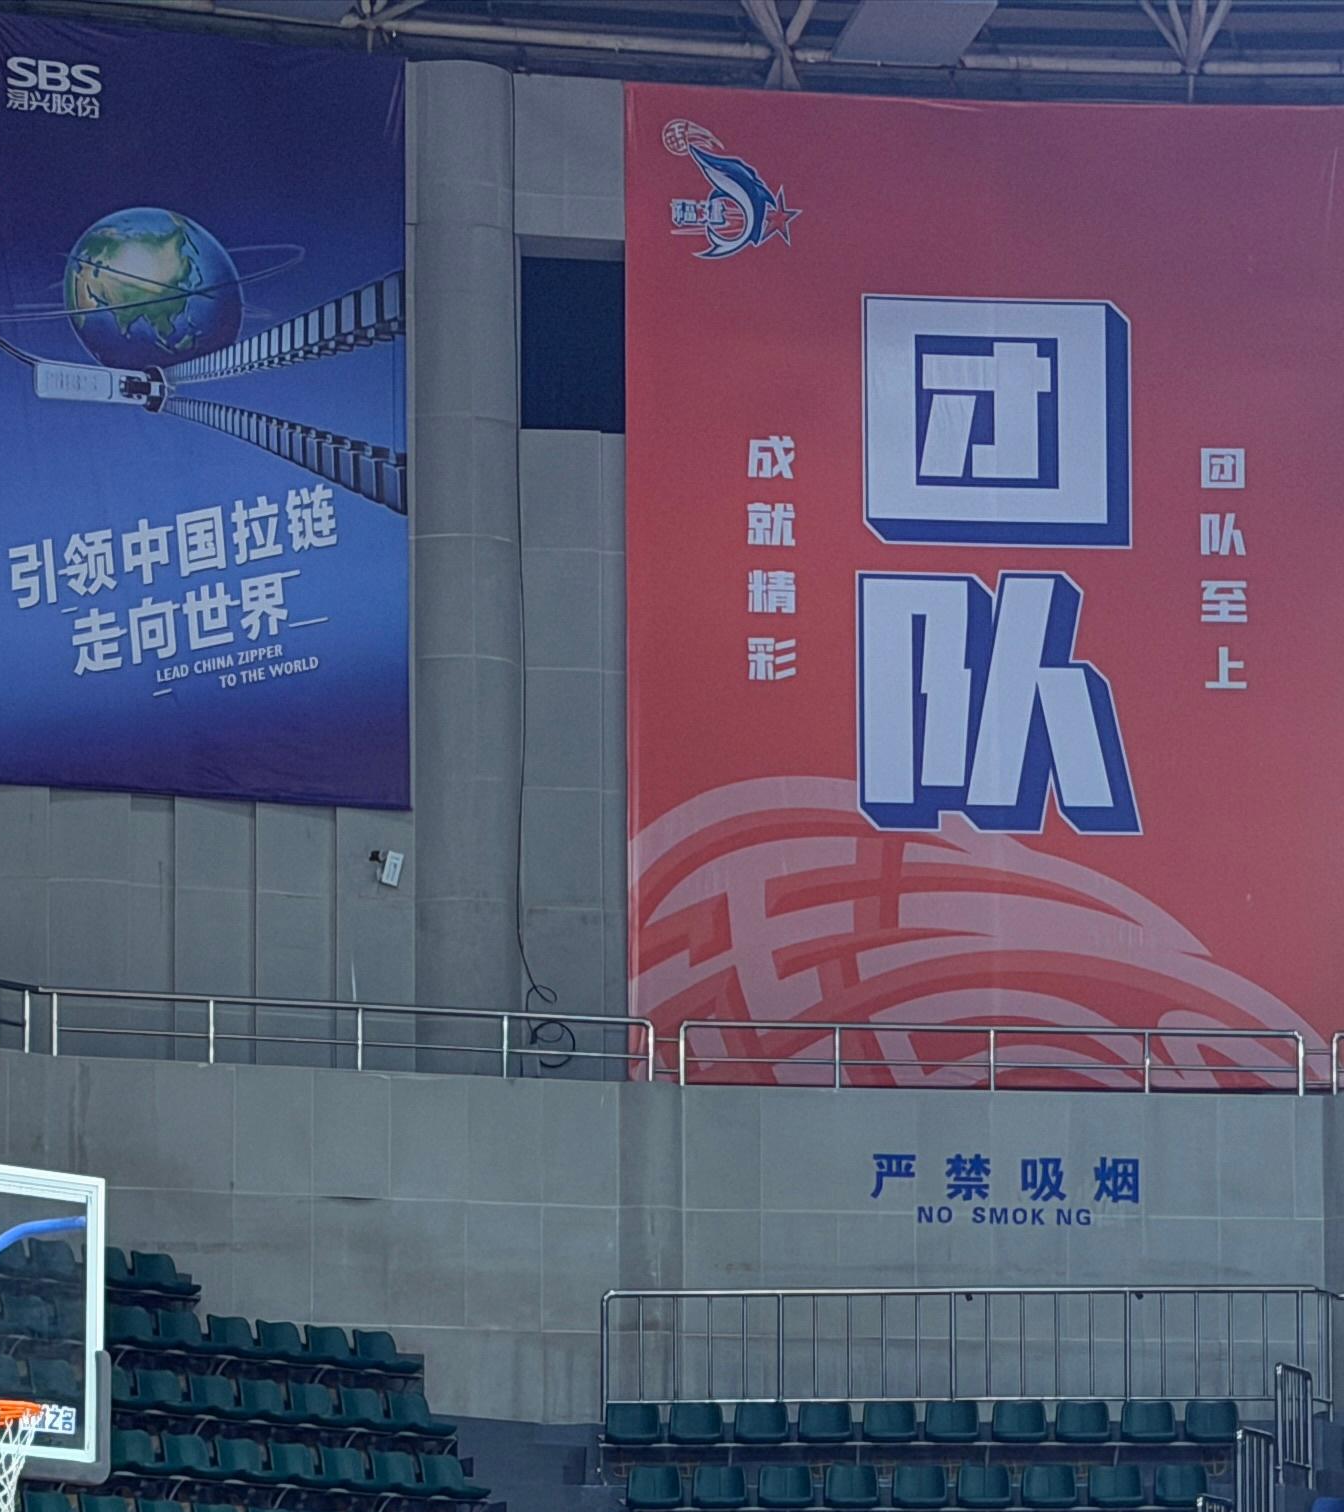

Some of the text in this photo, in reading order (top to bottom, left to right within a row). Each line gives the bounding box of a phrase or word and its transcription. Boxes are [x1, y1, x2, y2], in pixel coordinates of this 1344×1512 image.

[6, 56, 102, 94] SBS
[8, 483, 338, 608] 引领中国拉链
[747, 434, 797, 682] 成就精彩
[856, 293, 1143, 835] 团队
[1200, 447, 1248, 691] 团队至上
[71, 571, 301, 676] 走向世界
[156, 644, 284, 683] LEAD CHINA ZIPPER
[219, 656, 320, 689] TO THE WORLD
[870, 1153, 1140, 1204] 严禁吸烟
[917, 1206, 953, 1224] NO
